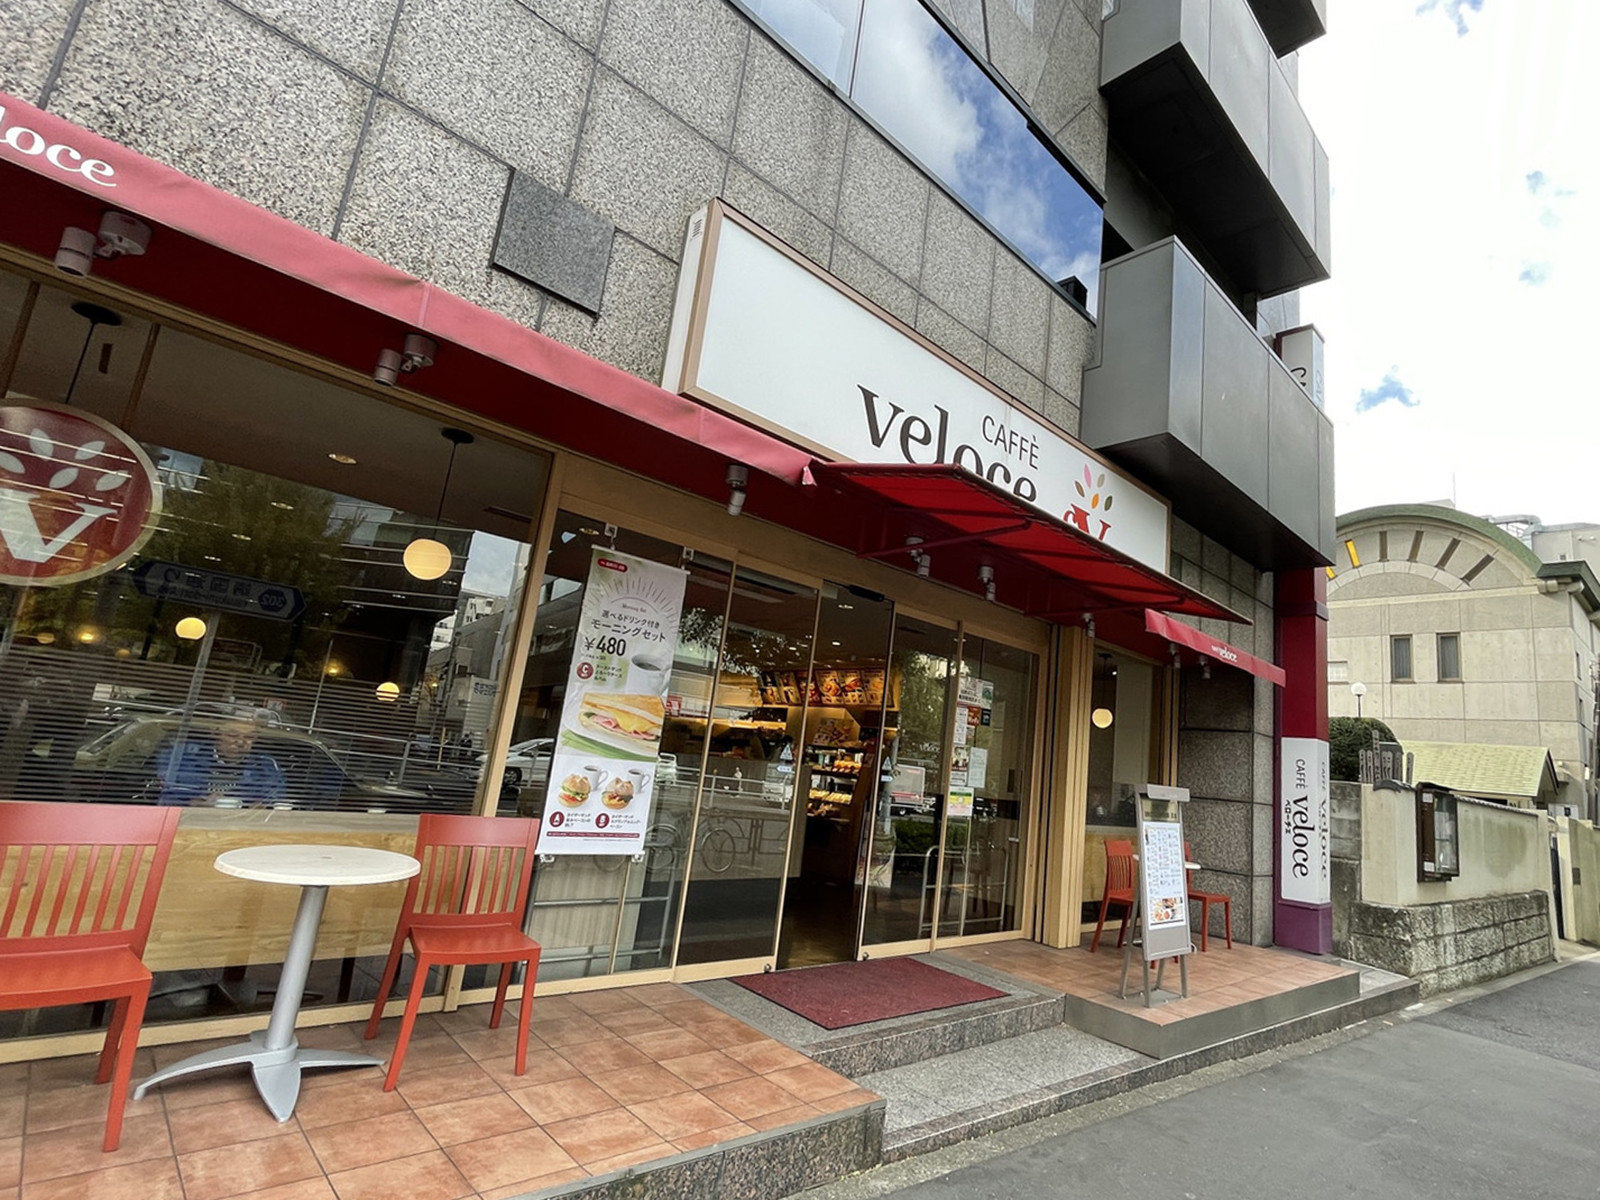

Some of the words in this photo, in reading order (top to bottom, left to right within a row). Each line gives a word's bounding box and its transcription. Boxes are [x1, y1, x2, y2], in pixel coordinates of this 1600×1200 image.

[982, 415, 1040, 470] CAFFÈ
[591, 618, 666, 642] モーニングセット
[1292, 795, 1315, 879] veloce
